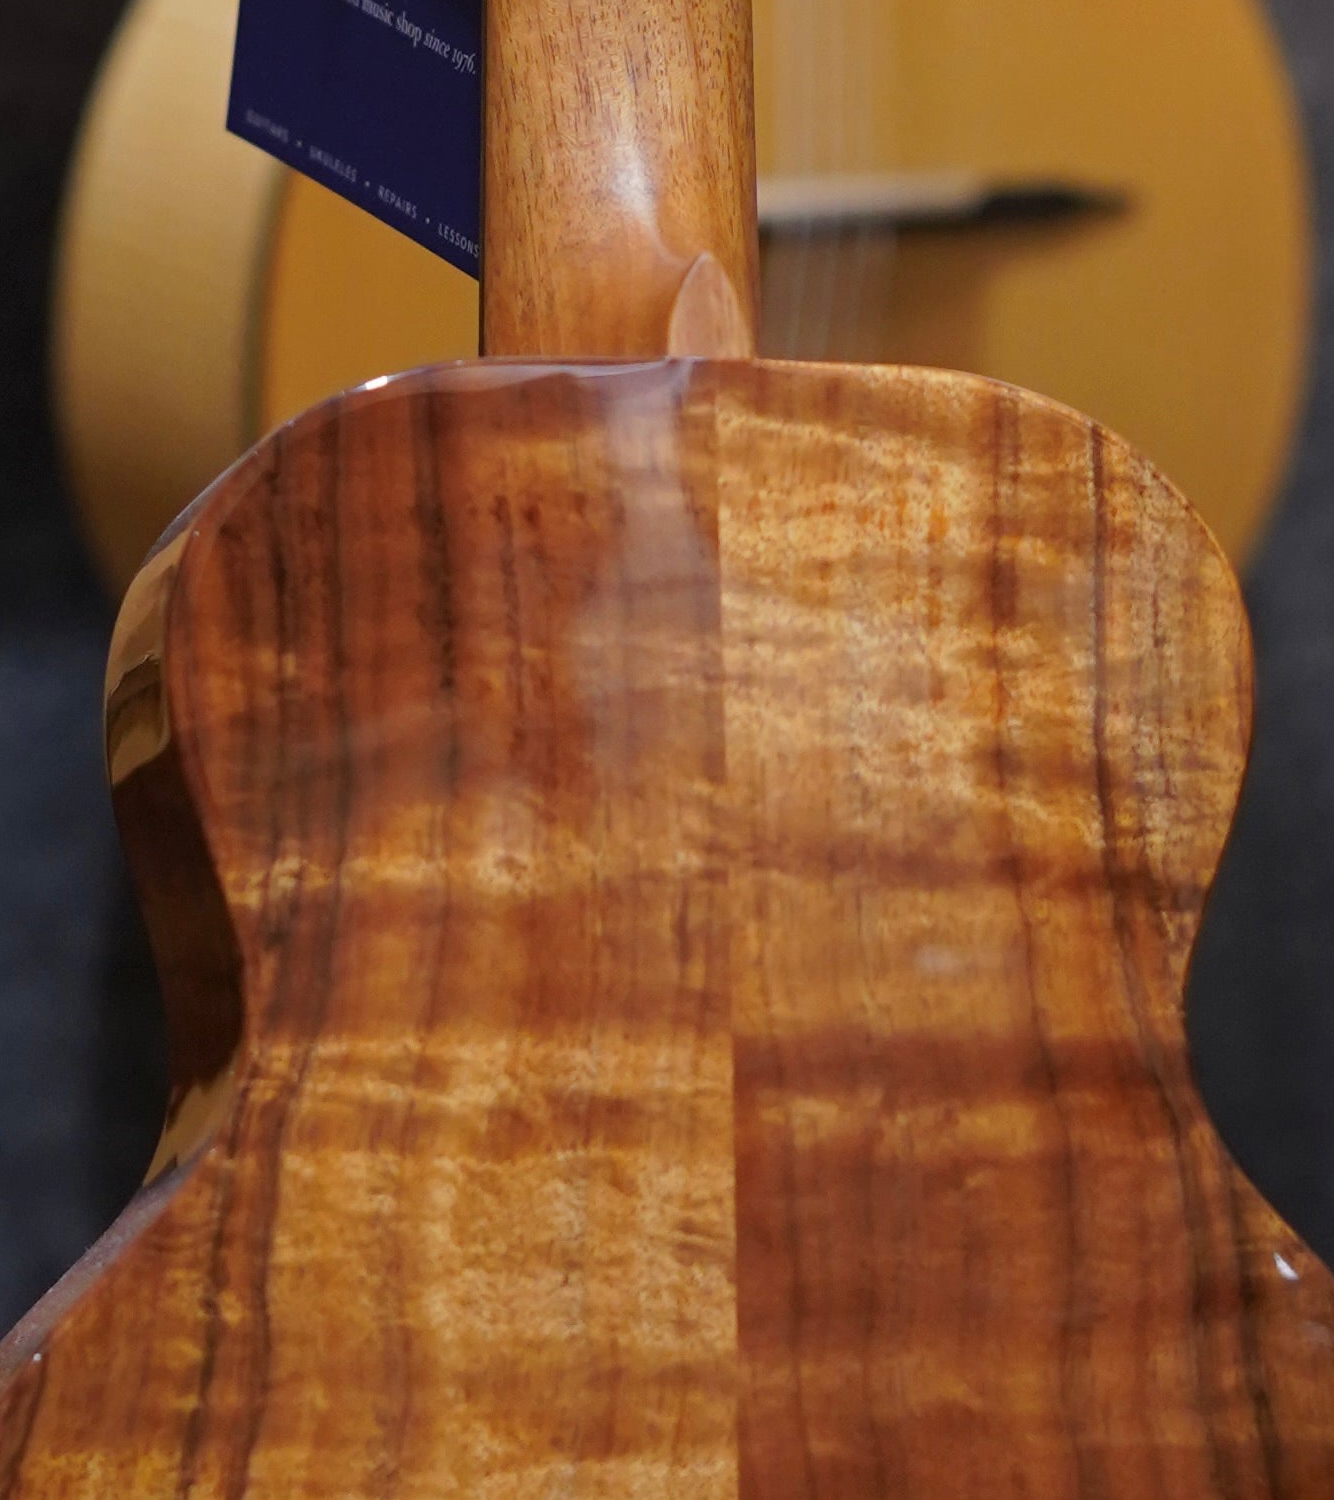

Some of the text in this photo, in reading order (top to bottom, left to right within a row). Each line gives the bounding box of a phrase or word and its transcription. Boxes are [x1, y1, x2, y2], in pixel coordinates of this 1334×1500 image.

[396, 10, 422, 49] shop
[423, 27, 450, 59] since
[451, 48, 476, 75] 1976.
[309, 145, 358, 183] UKULELES
[378, 184, 418, 220] REPAIRS
[437, 222, 480, 259] LESSONS
